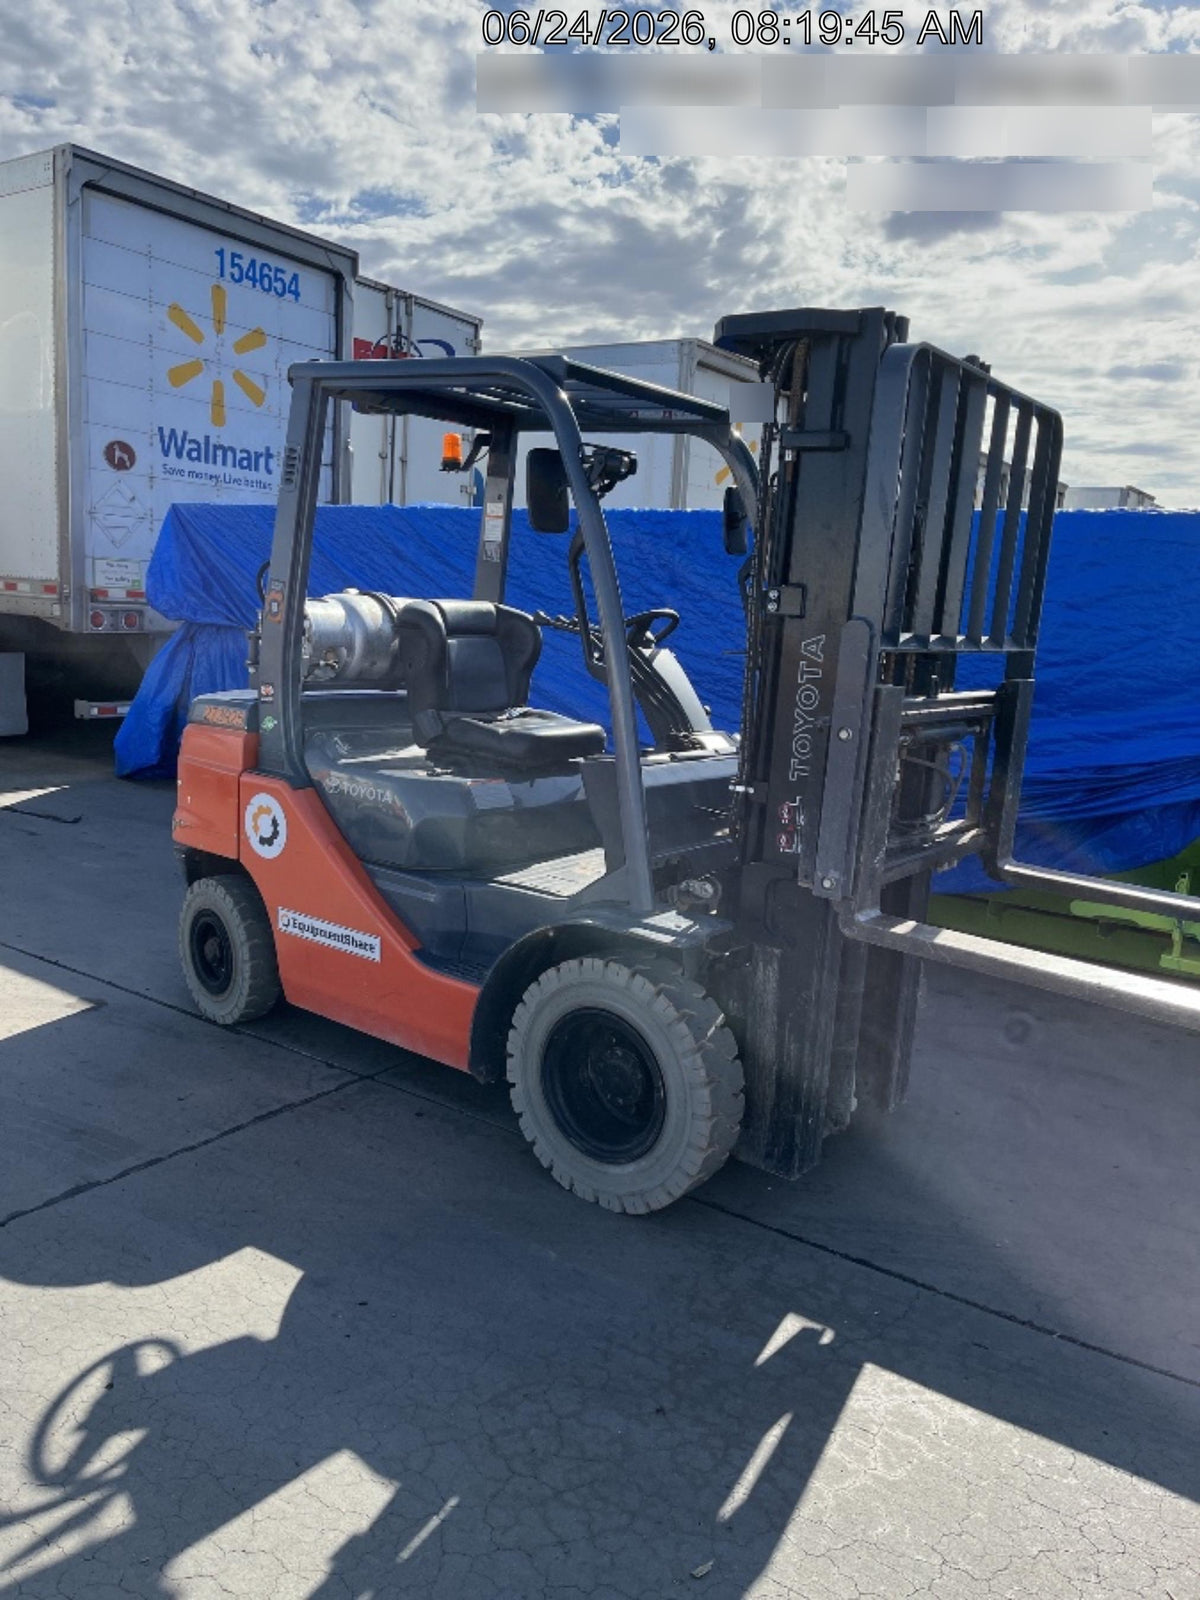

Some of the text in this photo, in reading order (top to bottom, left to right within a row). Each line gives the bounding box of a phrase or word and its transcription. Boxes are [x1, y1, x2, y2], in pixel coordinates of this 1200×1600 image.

[214, 247, 301, 303] 154654
[158, 426, 274, 475] Walmart
[161, 463, 186, 477] Save
[223, 472, 242, 486] Live
[789, 634, 826, 781] TOYOTA
[342, 781, 393, 804] TOYOTA
